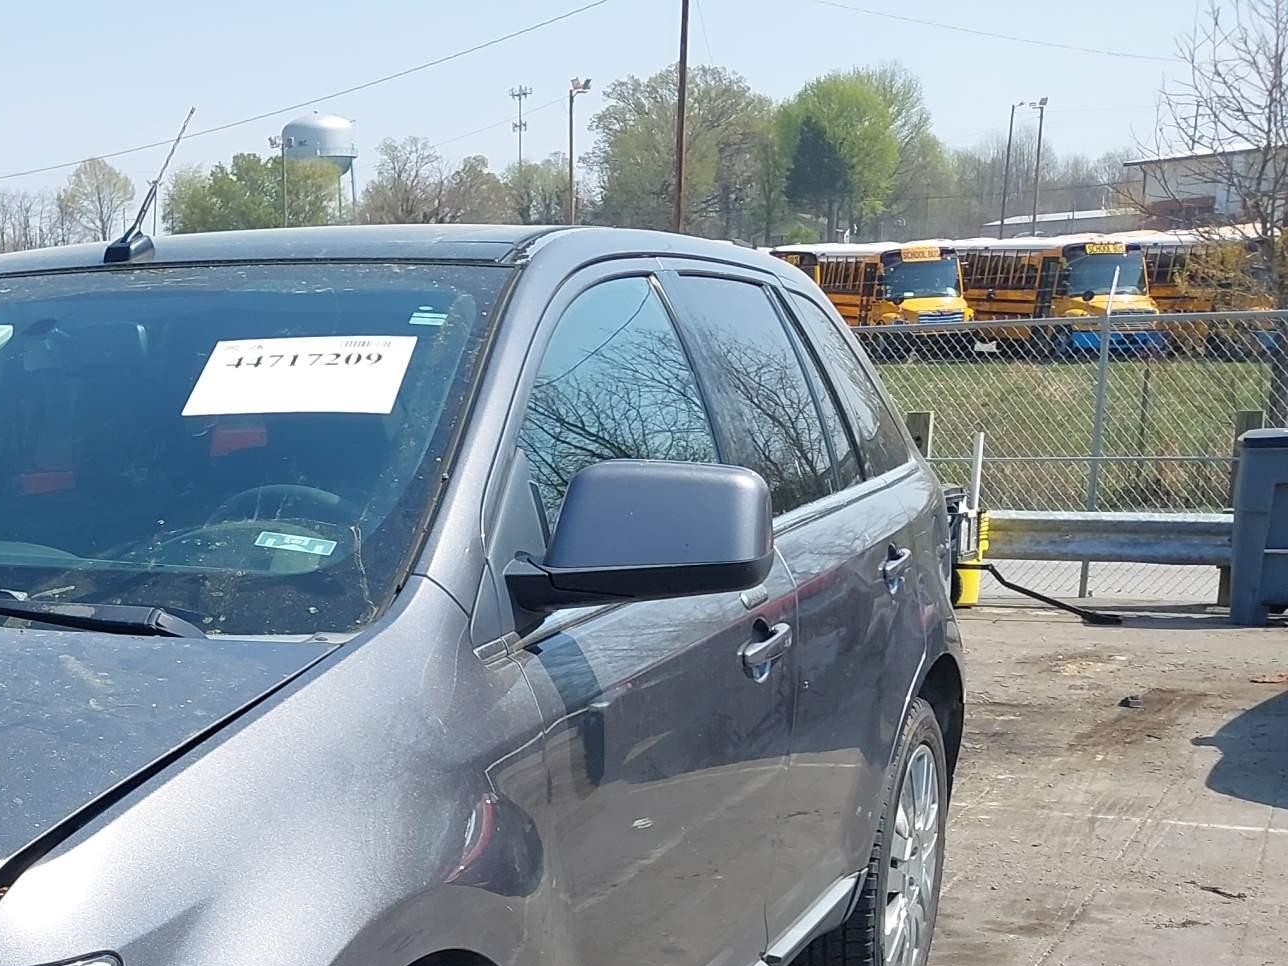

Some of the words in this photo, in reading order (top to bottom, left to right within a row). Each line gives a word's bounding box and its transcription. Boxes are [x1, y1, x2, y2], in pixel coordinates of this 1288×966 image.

[903, 250, 927, 259] SCHOOL
[928, 249, 939, 257] BUS
[1087, 245, 1111, 253] SCHOOL
[226, 352, 383, 369] 44717209
